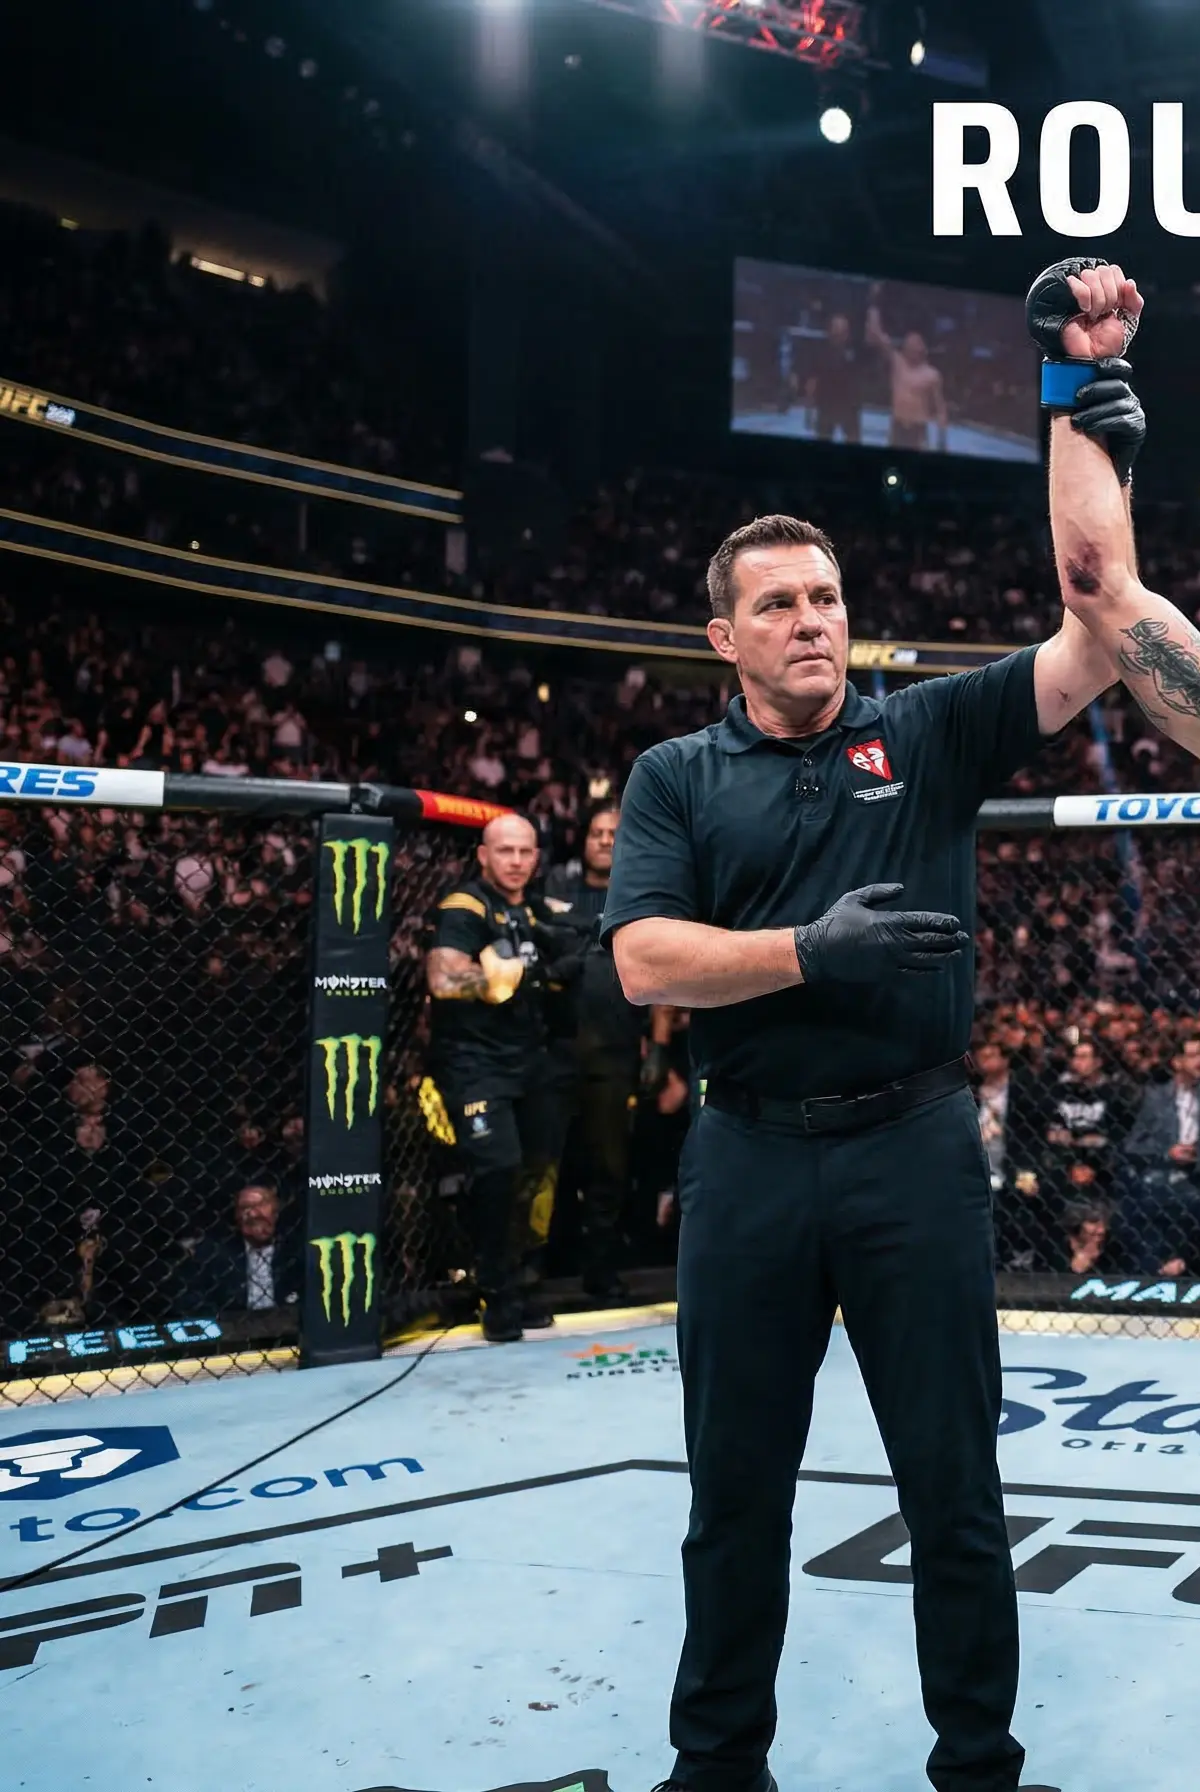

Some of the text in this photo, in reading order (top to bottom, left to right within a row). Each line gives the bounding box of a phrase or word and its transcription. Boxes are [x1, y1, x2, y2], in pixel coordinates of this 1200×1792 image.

[0, 766, 98, 797] RES
[315, 974, 387, 990] MONSTER
[308, 1172, 382, 1189] MONSTER
